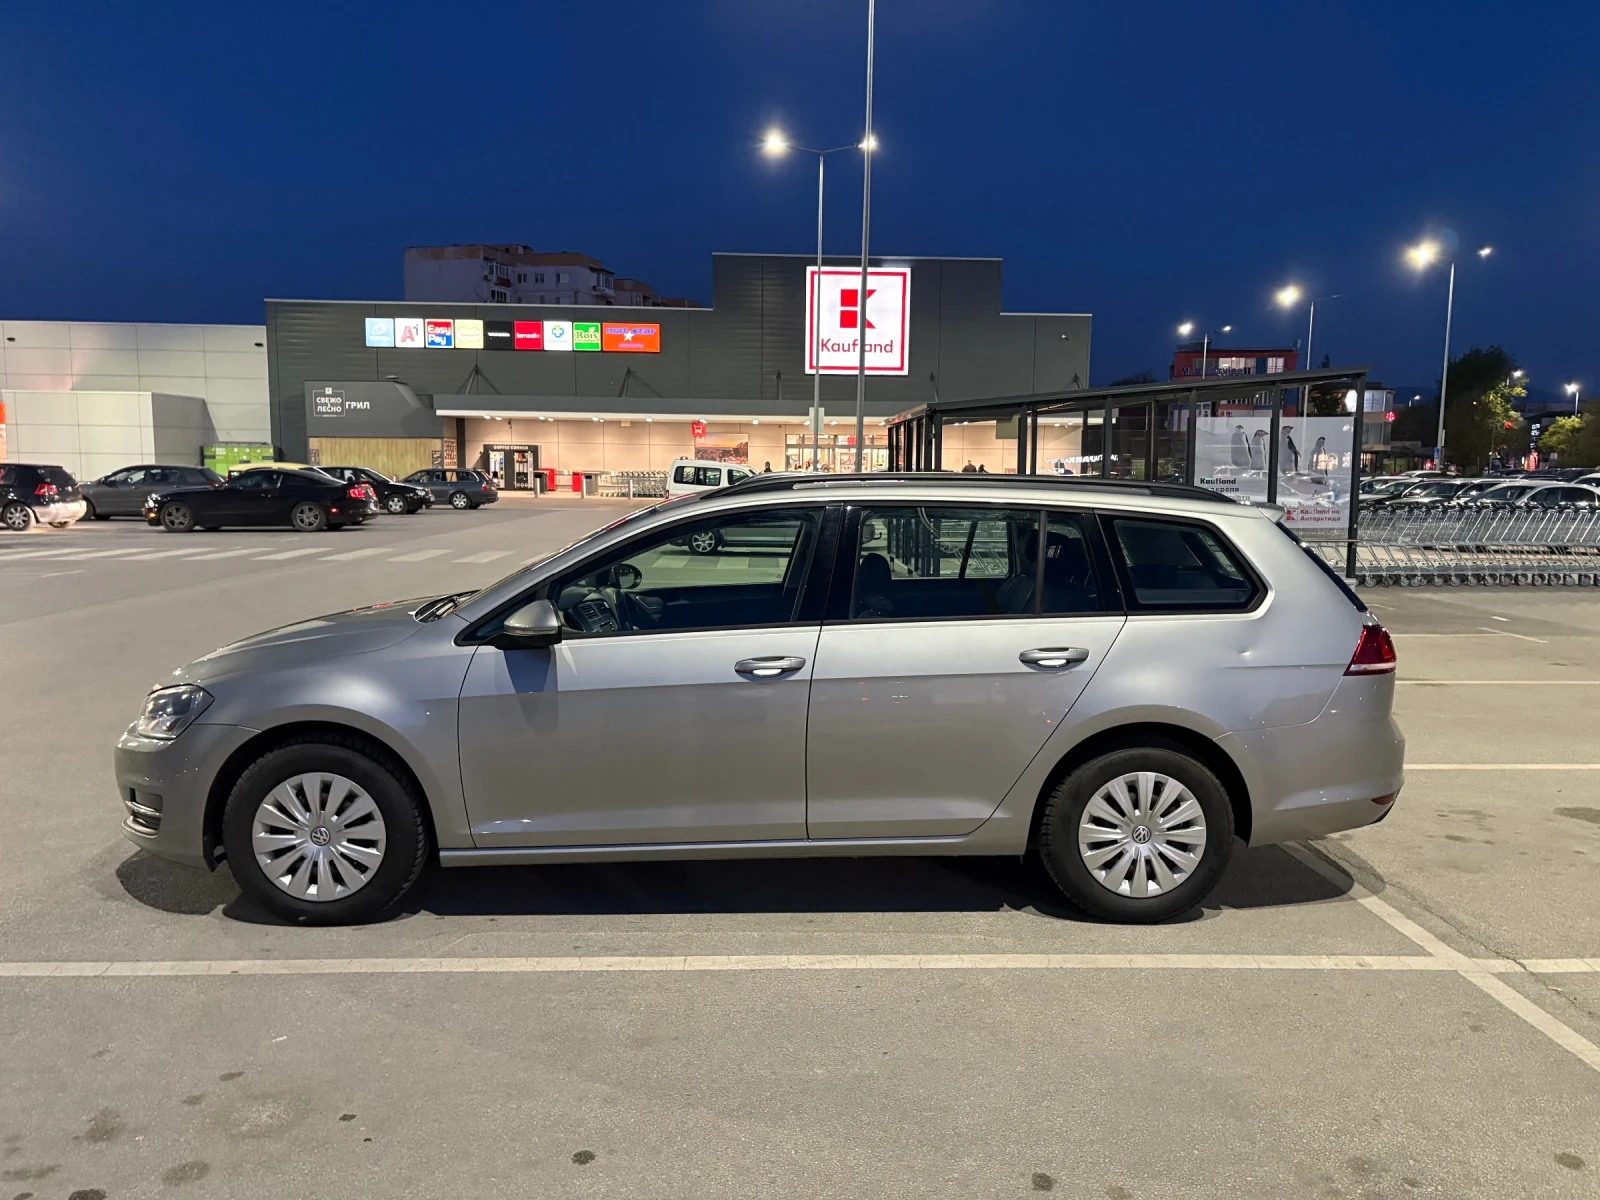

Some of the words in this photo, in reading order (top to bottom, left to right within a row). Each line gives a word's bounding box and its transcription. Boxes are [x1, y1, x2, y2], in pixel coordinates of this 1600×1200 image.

[428, 325, 451, 336] Easy
[576, 331, 598, 339] Rois
[428, 334, 446, 345] Pay
[820, 338, 894, 353] Kaufand
[317, 405, 342, 413] ЛЕСНО
[345, 401, 370, 410] ГРИЛ
